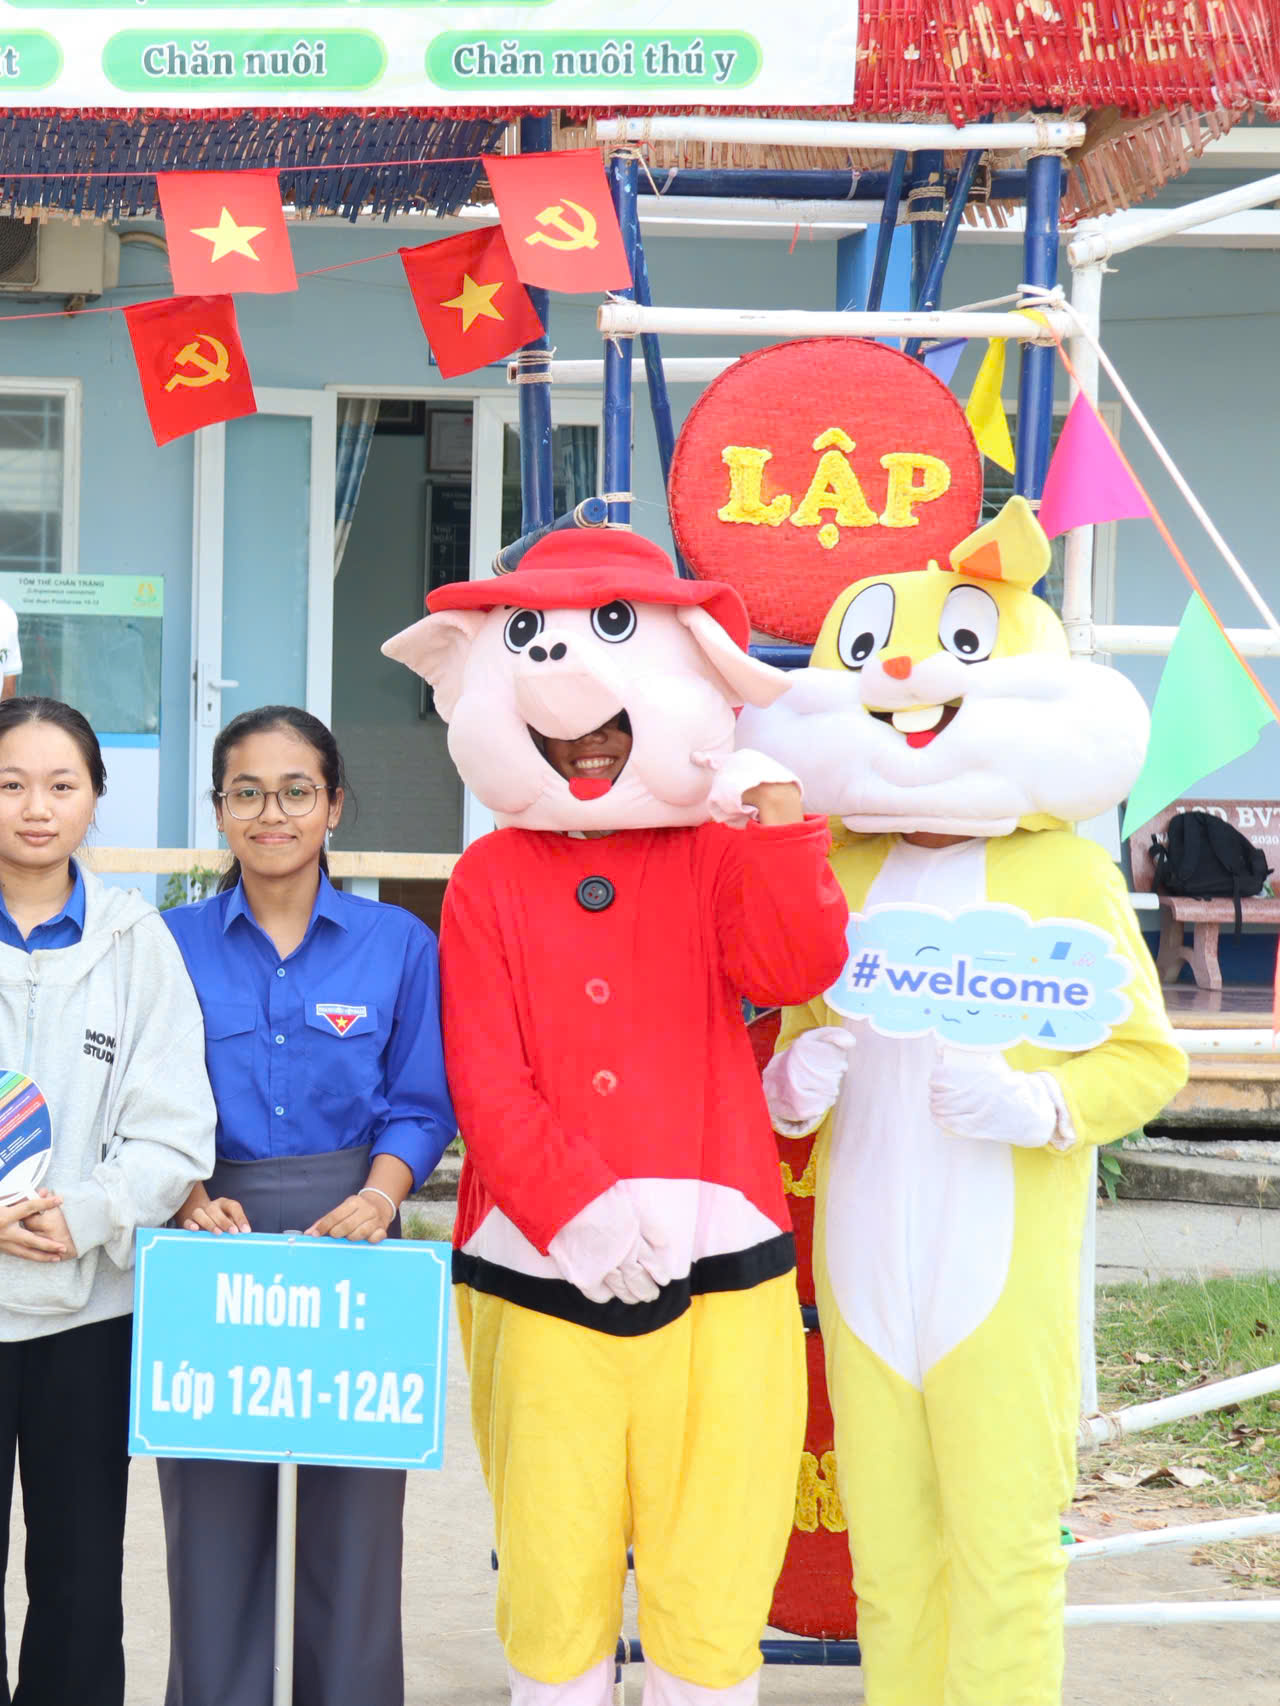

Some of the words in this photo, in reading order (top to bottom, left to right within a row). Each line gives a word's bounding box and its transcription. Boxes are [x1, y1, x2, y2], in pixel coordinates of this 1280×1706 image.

[143, 42, 235, 77] Chăn
[244, 41, 327, 76] nuôi
[453, 44, 544, 77] Chăn
[553, 41, 635, 76] nuôi
[644, 40, 704, 76] thú
[713, 51, 737, 82] y
[717, 427, 952, 549] LẬP
[853, 953, 1089, 1006] #welcome
[216, 1272, 321, 1328] Nhóm
[335, 1279, 367, 1331] 1:
[151, 1360, 216, 1421] Lớp
[227, 1365, 425, 1425] 12A1-12A2
